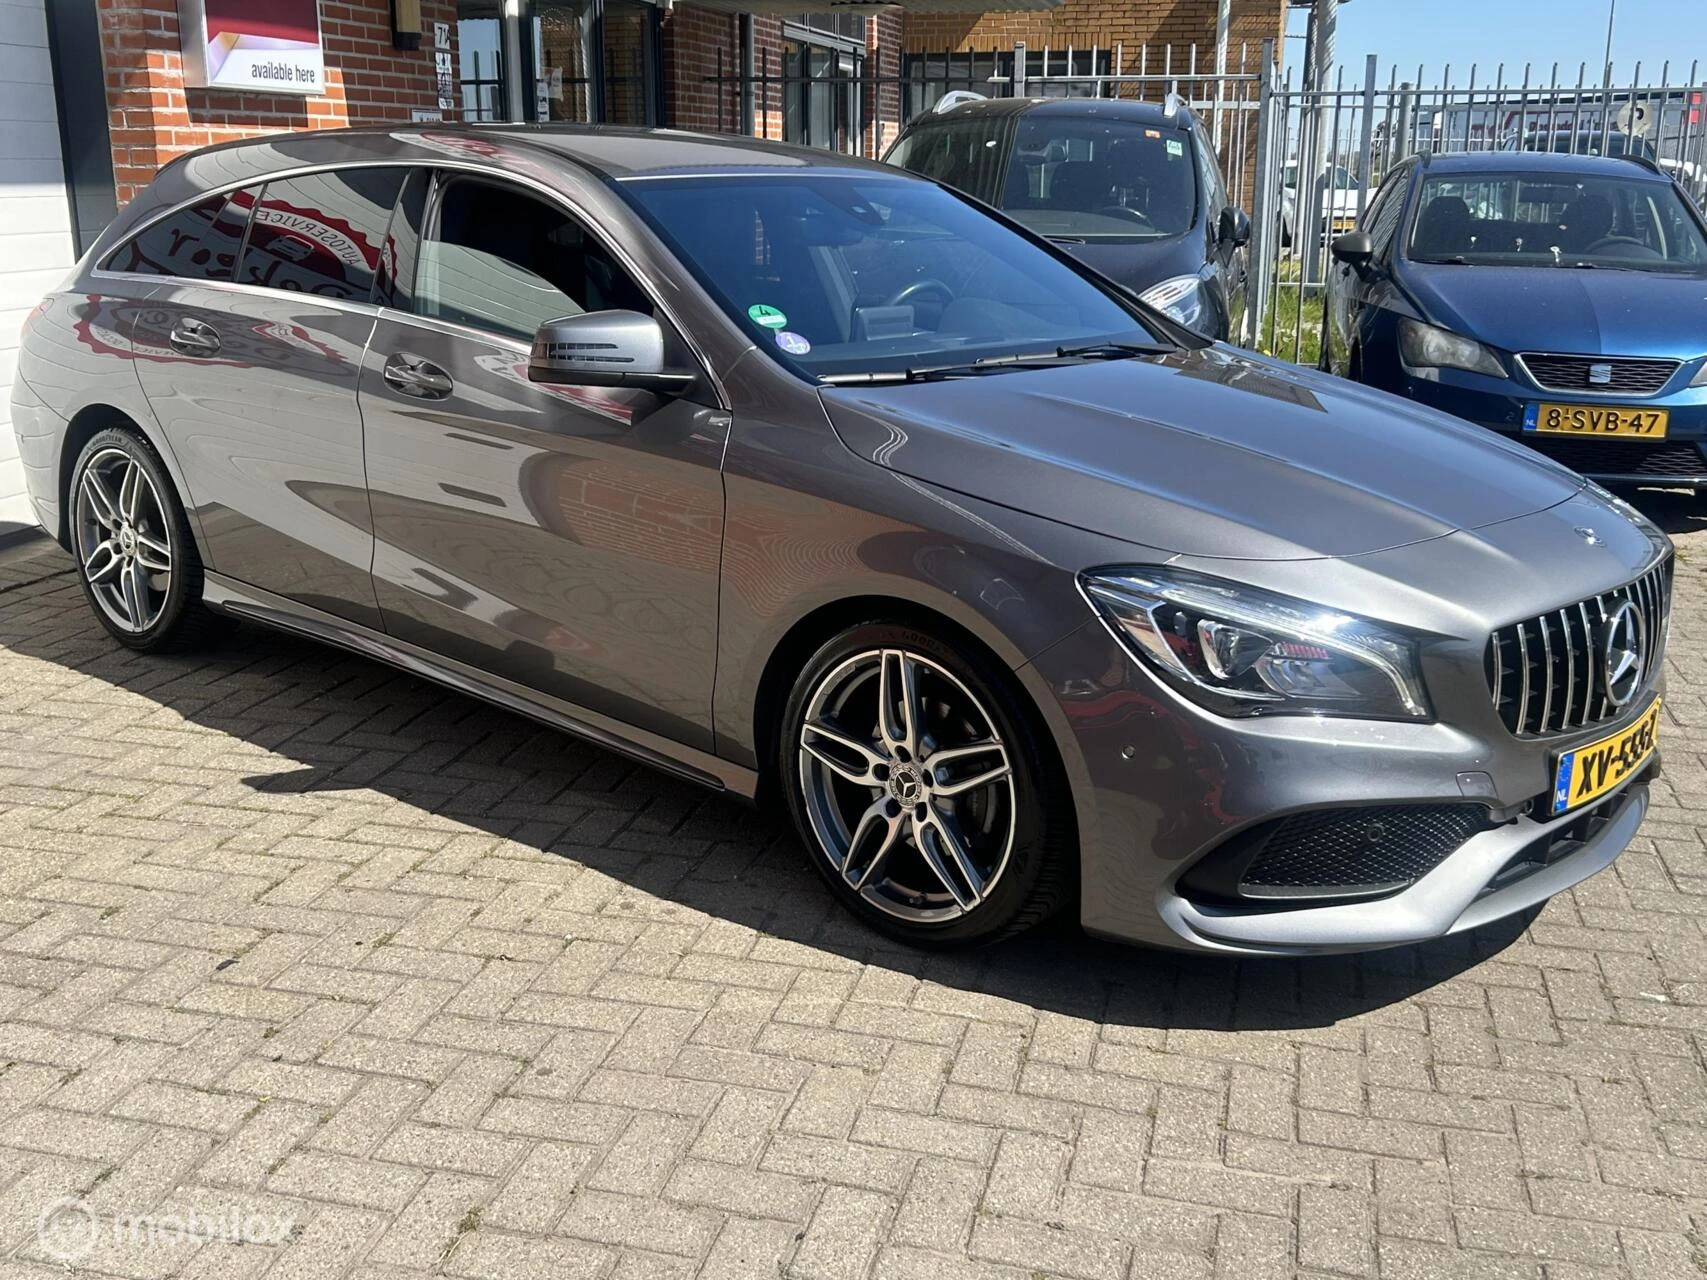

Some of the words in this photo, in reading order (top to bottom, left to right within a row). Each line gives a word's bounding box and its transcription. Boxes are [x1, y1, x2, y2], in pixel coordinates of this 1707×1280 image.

[251, 61, 293, 81] available
[295, 64, 316, 84] here
[1546, 408, 1660, 433] 8-SVB-47
[1556, 788, 1568, 802] NL
